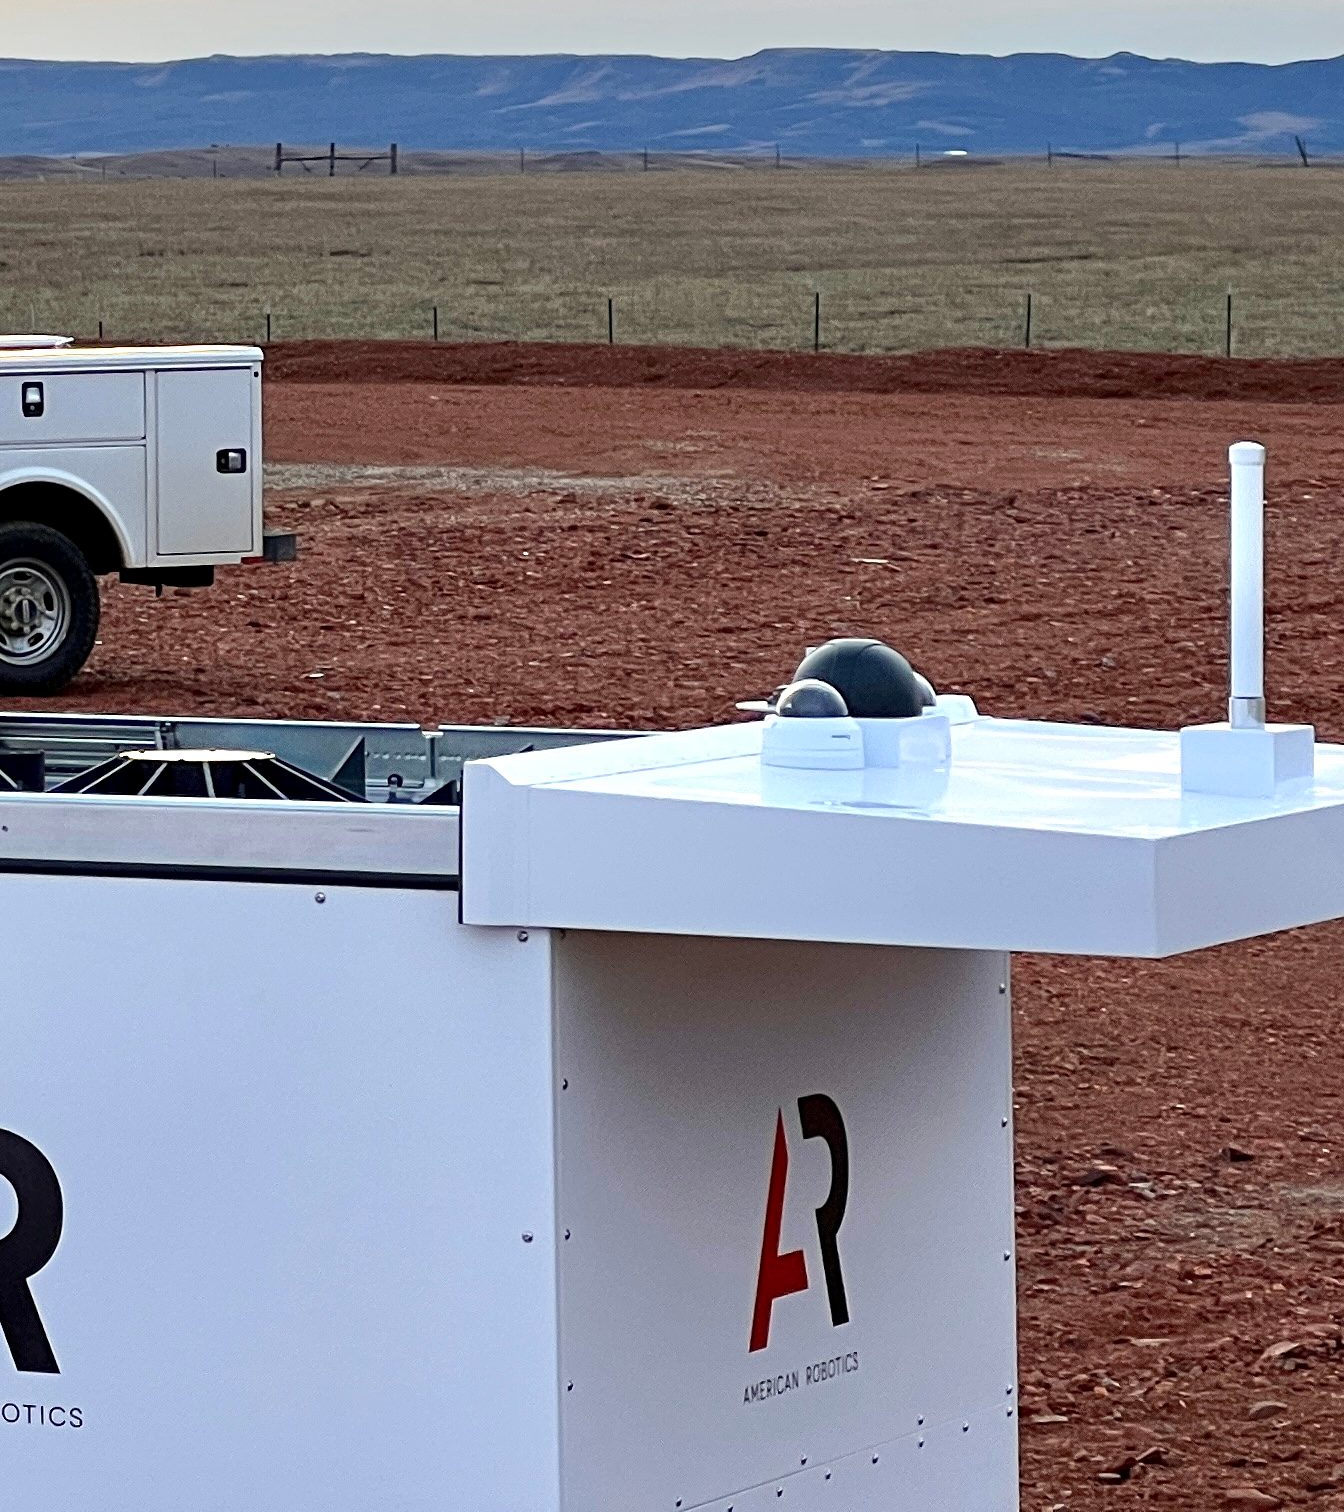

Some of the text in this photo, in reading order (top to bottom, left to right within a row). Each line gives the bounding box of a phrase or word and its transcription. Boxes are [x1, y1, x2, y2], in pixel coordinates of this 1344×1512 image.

[748, 1092, 850, 1354] AR
[742, 1350, 860, 1405] AMERICAN ROBOTICS
